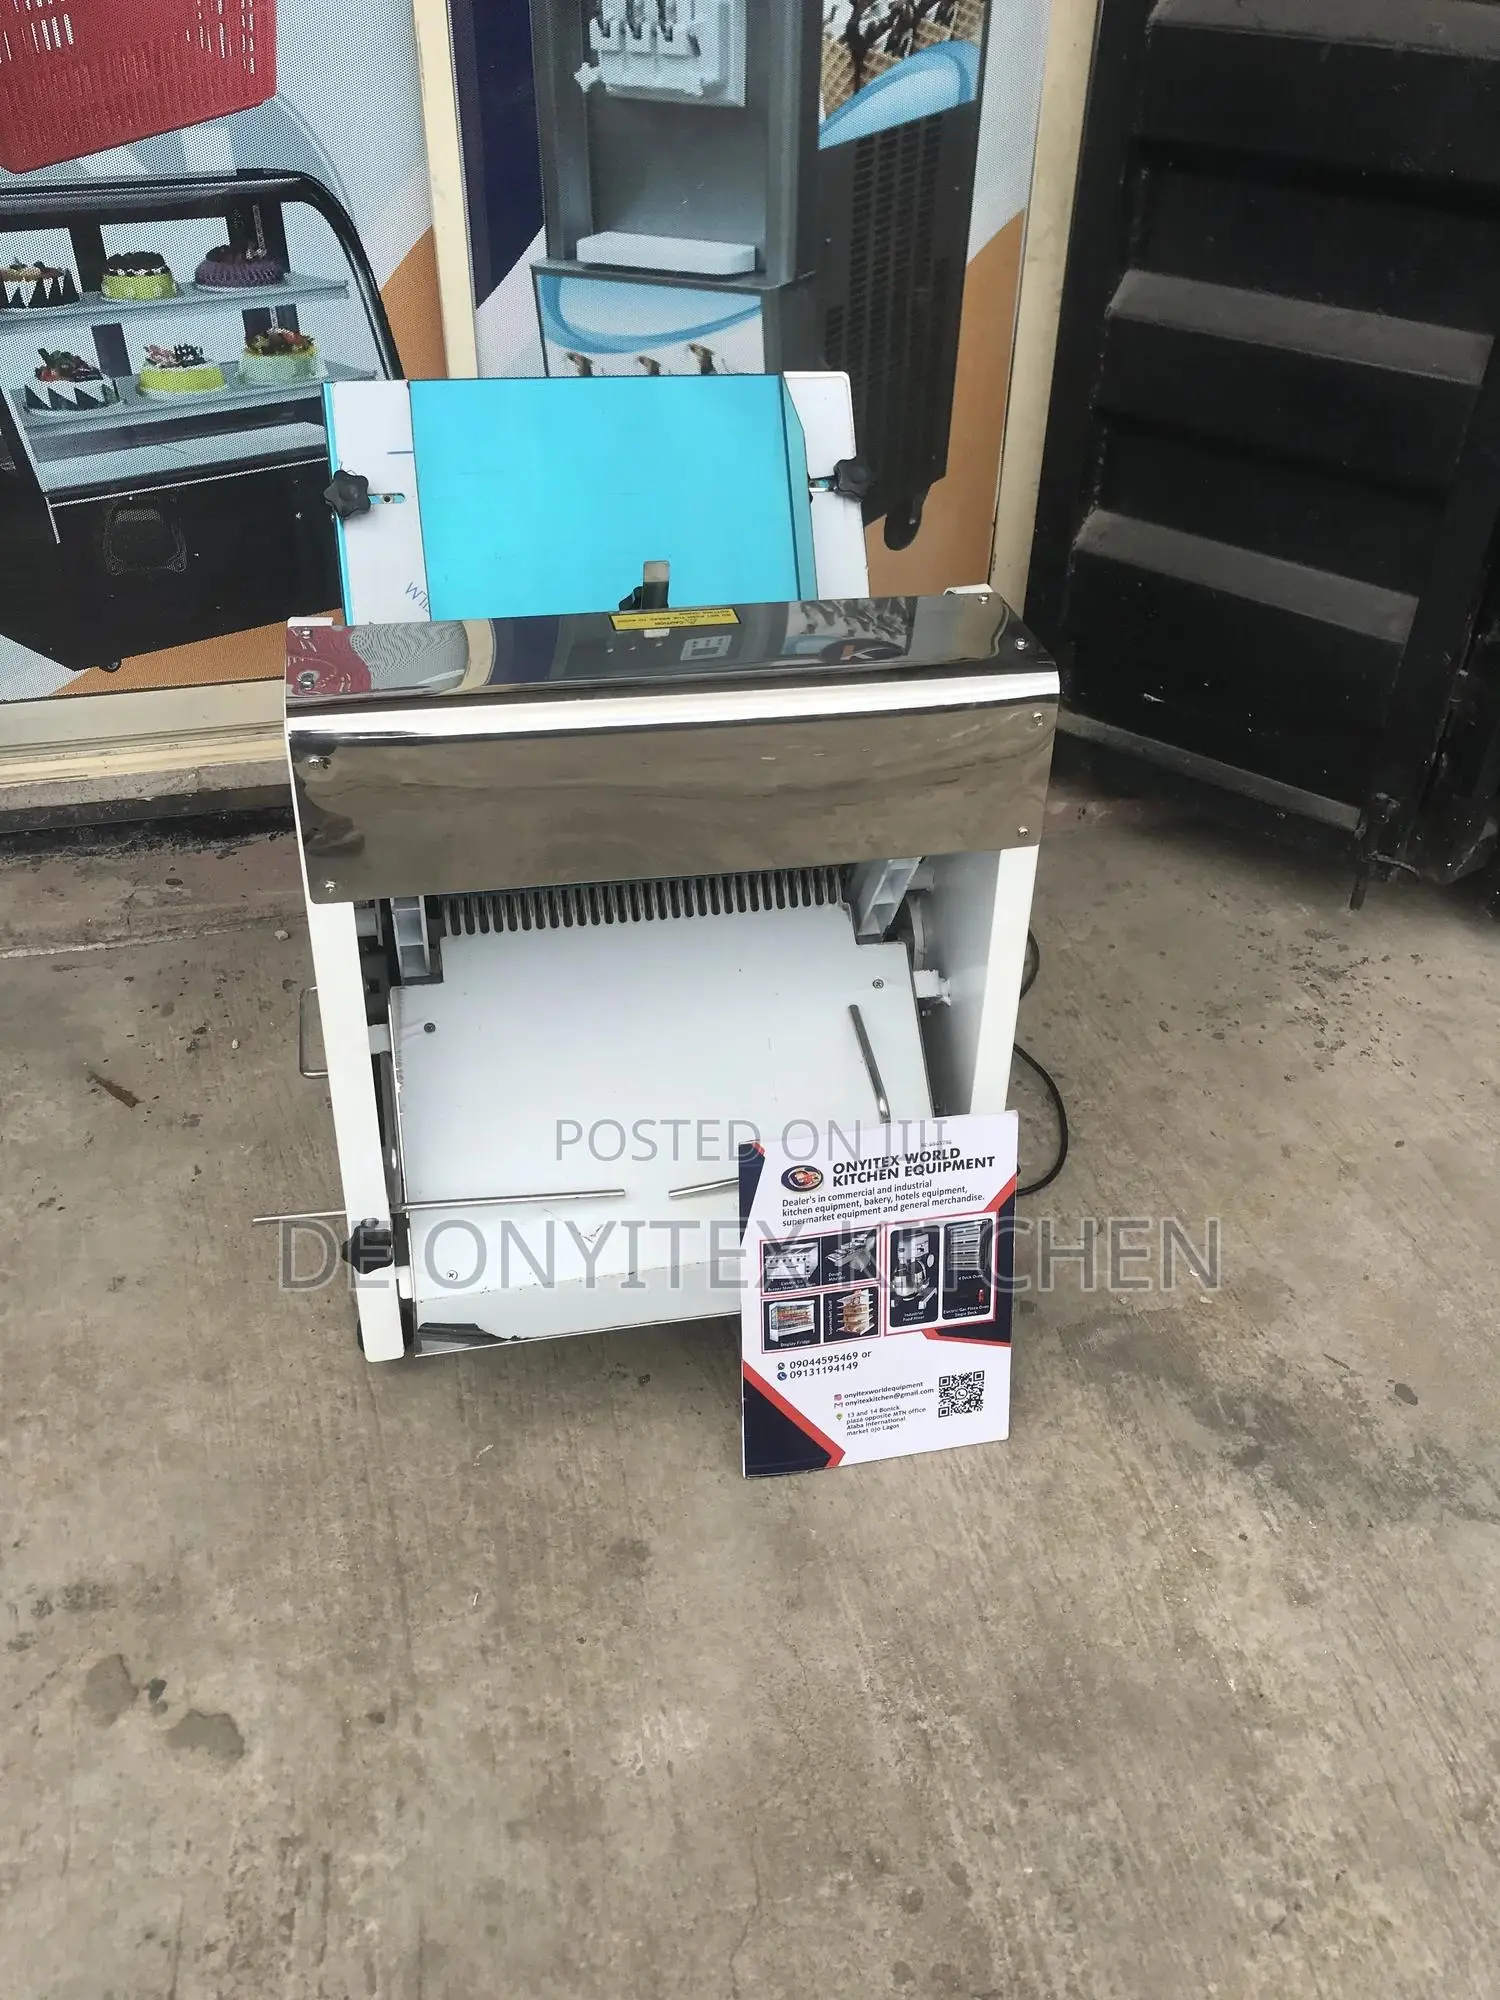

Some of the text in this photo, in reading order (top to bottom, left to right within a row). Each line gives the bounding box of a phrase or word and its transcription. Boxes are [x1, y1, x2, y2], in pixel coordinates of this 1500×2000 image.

[833, 1148, 960, 1174] ONYITEX WORLD
[833, 1156, 995, 1187] KITCHEN EQUIPMENT
[782, 1180, 932, 1207] Dealer's in commercial and industrial
[782, 1186, 967, 1217] kitchen equipment, bakery, hotels equipment,
[782, 1194, 985, 1227] supermarket equipment and general merchandise.
[789, 1351, 872, 1369] 09044595469 or
[789, 1361, 859, 1379] 09131194149
[844, 1382, 924, 1399] onyitexworldequipment
[845, 1388, 935, 1407] onyitexkitchen@gmail.com
[846, 1418, 864, 1426] plaza
[864, 1413, 892, 1422] opposite
[908, 1407, 927, 1415] office
[865, 1416, 906, 1427] International
[846, 1428, 869, 1436] market
